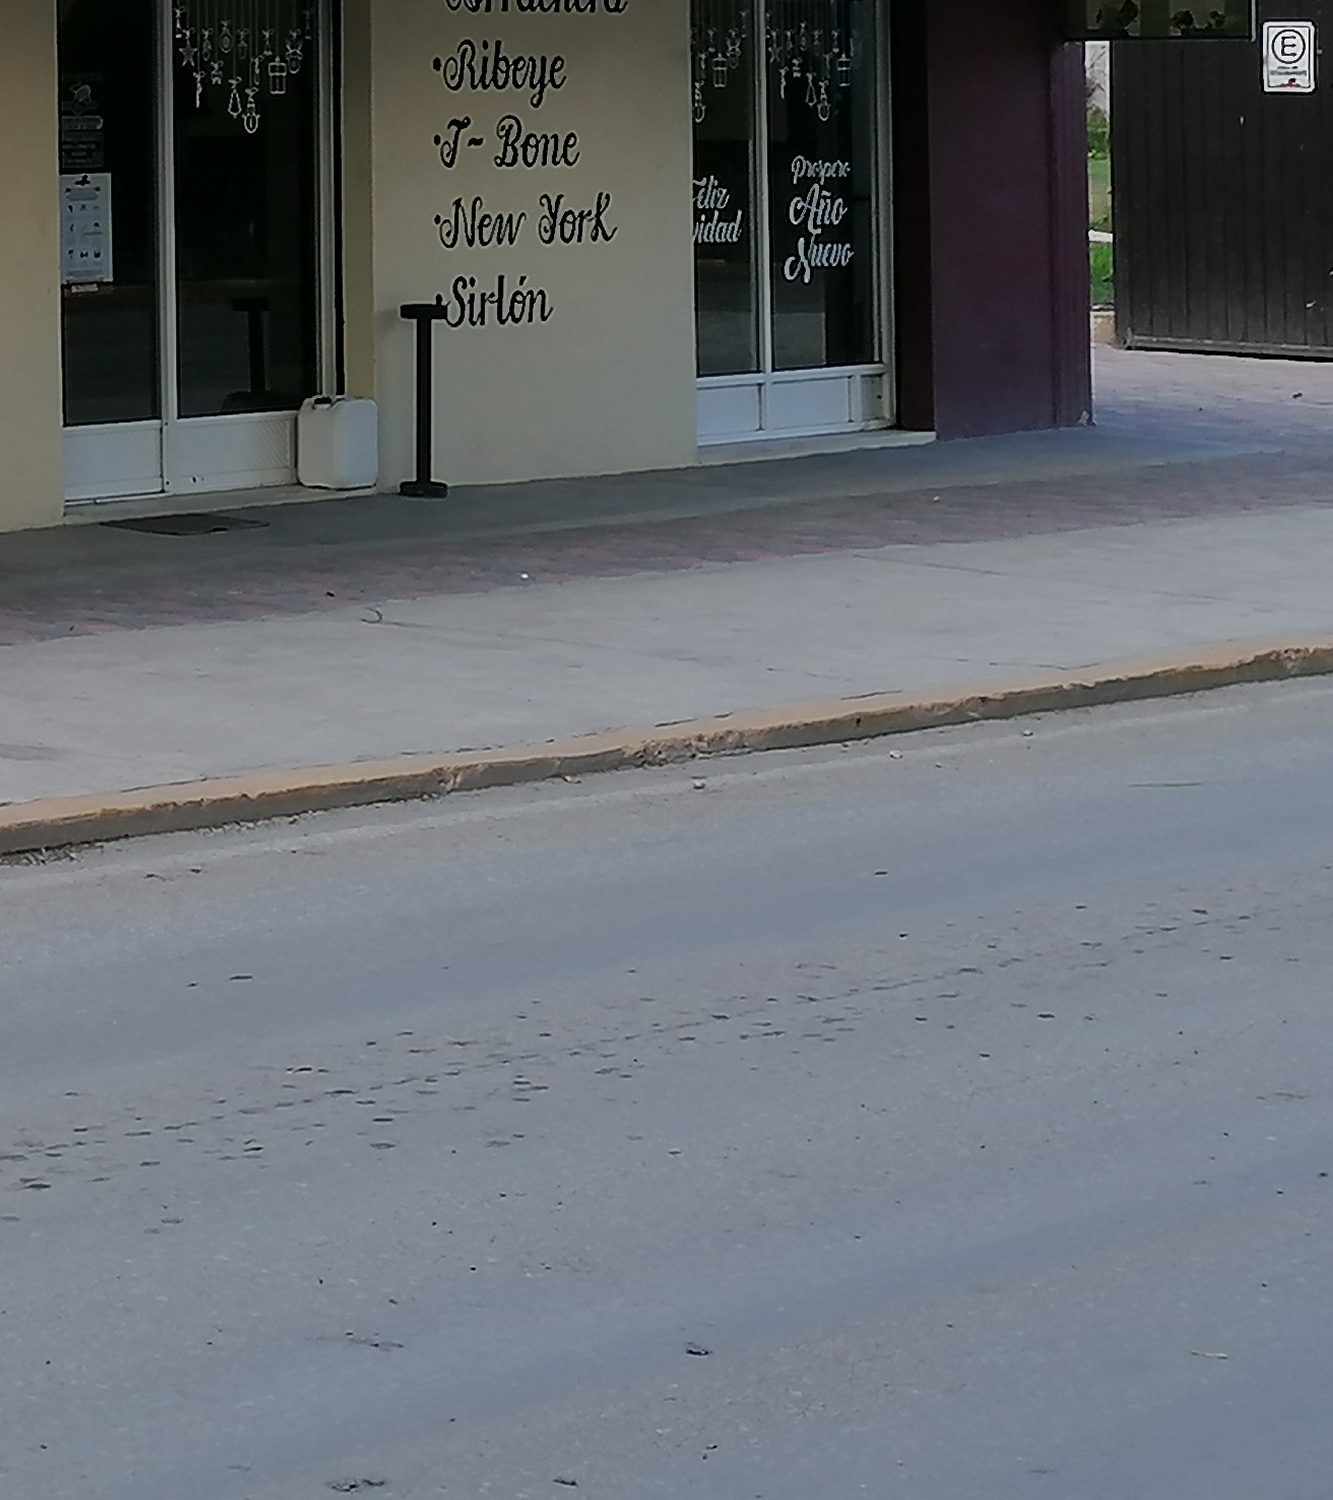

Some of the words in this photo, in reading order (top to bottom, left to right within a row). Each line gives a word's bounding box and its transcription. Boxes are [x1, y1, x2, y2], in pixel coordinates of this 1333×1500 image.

[443, 38, 567, 109] Ribeye
[494, 114, 580, 168] Bone
[439, 196, 526, 249] New
[539, 192, 618, 245] York
[789, 183, 848, 235] Año
[784, 234, 854, 283] Nuevo
[445, 274, 554, 328] Sirlón
